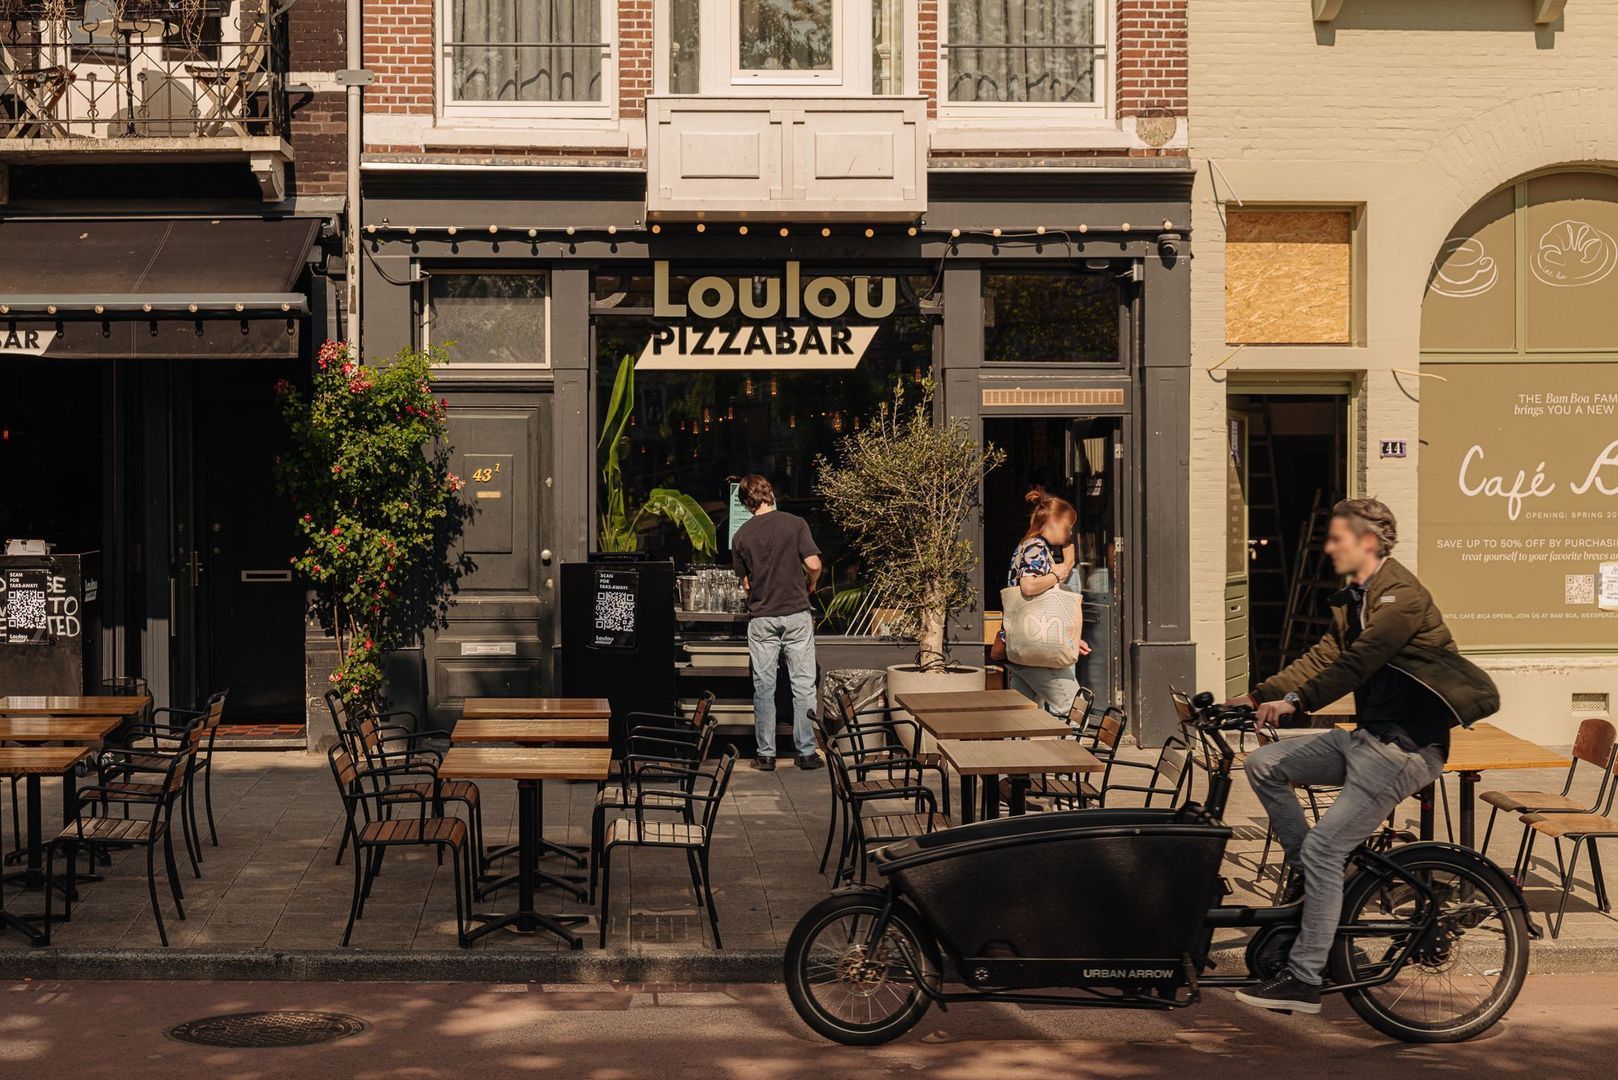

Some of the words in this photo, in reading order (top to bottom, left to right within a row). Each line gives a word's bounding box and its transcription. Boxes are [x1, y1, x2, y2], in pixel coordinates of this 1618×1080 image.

[653, 260, 896, 319] Loulou
[0, 330, 40, 349] AR
[653, 326, 854, 355] PIZZABAR
[1518, 394, 1542, 404] THE
[1545, 392, 1568, 404] Bam
[1570, 392, 1590, 404] Boa
[1514, 404, 1544, 417] brings
[1547, 404, 1571, 415] YOU
[1575, 405, 1584, 415] A
[1587, 404, 1615, 415] NEW
[1459, 444, 1556, 521] Café
[1571, 511, 1604, 519] SPRING
[1436, 539, 1463, 549] SAVE
[1466, 539, 1481, 548] UP
[1483, 539, 1498, 548] TO
[1500, 539, 1521, 548] 50%
[1525, 539, 1546, 548] OFF
[1549, 539, 1562, 548] BY
[1462, 552, 1482, 561] treat
[1483, 551, 1518, 564] yourself
[1518, 552, 1528, 561] to
[1528, 552, 1548, 563] your
[1547, 551, 1583, 563] favorite
[1584, 551, 1610, 561] brews
[1083, 969, 1126, 978] URBAN
[1129, 969, 1174, 978] ARROW
